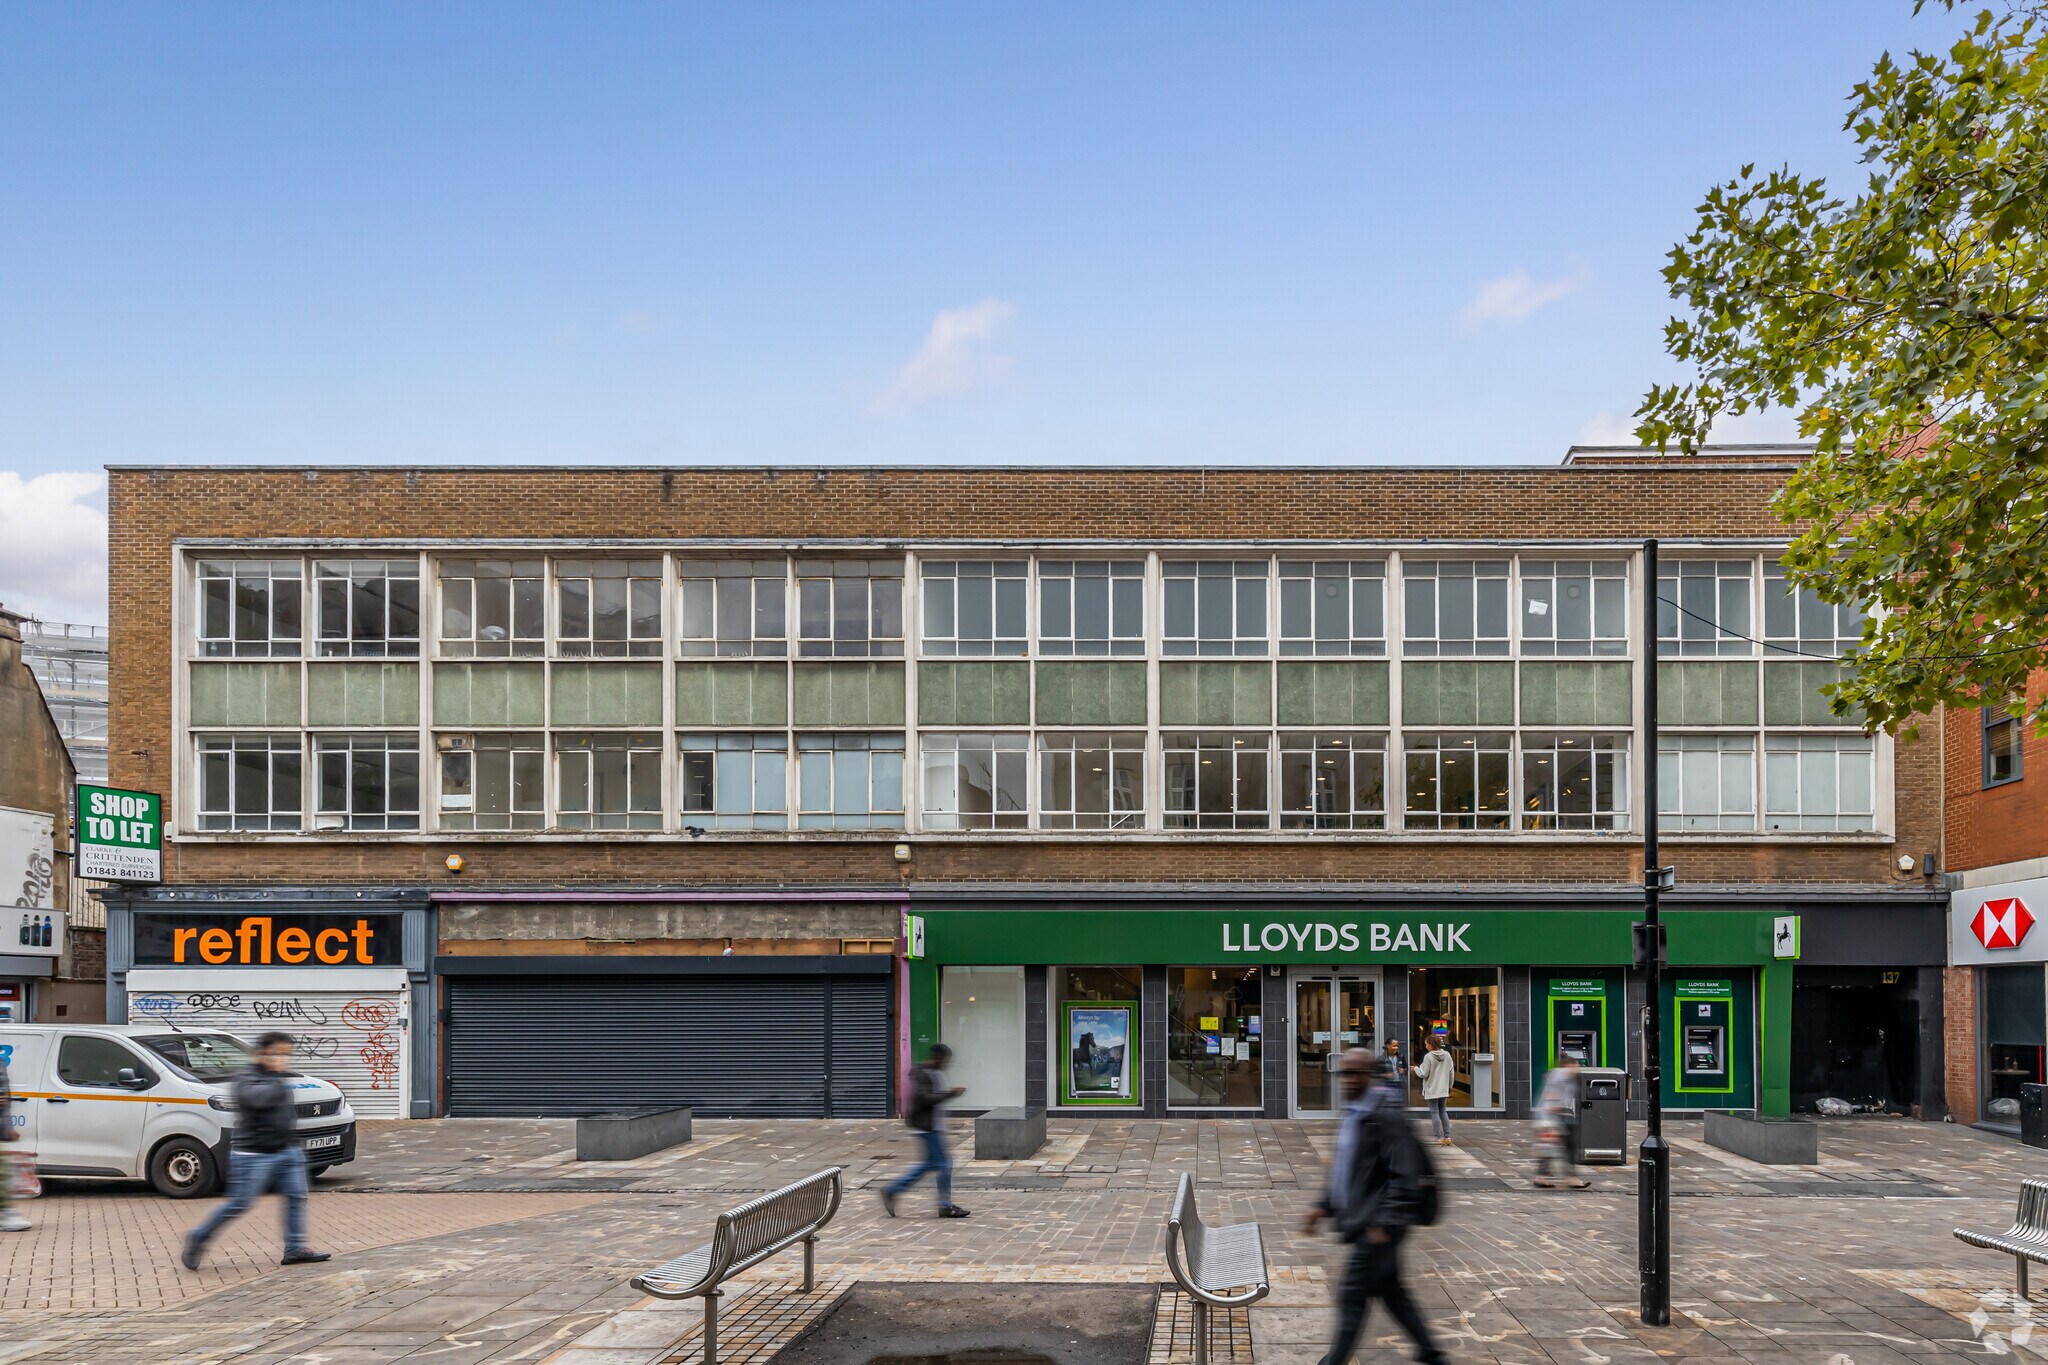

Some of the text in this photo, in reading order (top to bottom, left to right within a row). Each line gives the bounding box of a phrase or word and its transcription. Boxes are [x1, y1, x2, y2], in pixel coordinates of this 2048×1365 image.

[90, 792, 149, 819] SHOP
[86, 816, 153, 844] TO LET
[85, 852, 153, 864] CRITTENDEN
[85, 860, 120, 868] CHARTERED
[86, 866, 154, 879] 01843 841123
[173, 917, 374, 965] reflect
[1223, 923, 1472, 952] LLOYDS BANK
[1882, 971, 1900, 984] 137
[310, 1136, 338, 1148] FY71 UPP
